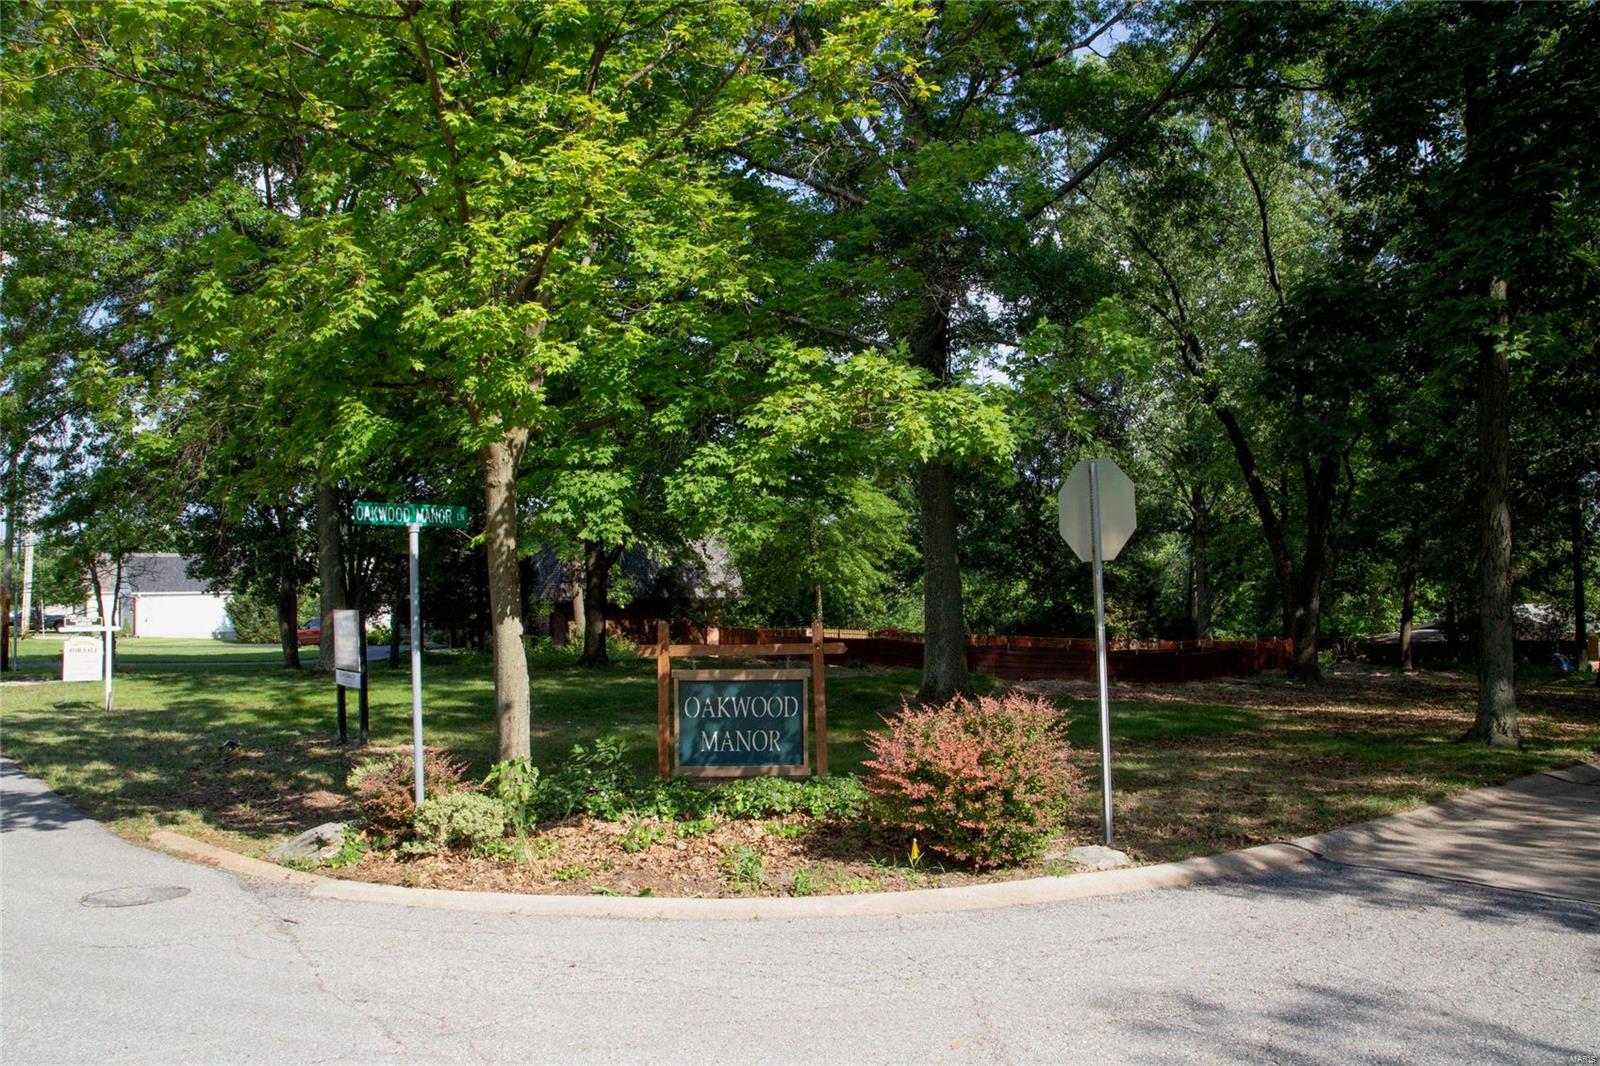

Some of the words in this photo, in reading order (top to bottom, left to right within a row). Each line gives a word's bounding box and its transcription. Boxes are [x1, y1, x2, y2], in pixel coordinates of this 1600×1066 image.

[356, 505, 410, 522] OAKWOOD
[416, 508, 452, 524] MANOR
[684, 696, 799, 718] OAKWOOD
[701, 730, 781, 752] MANOR
